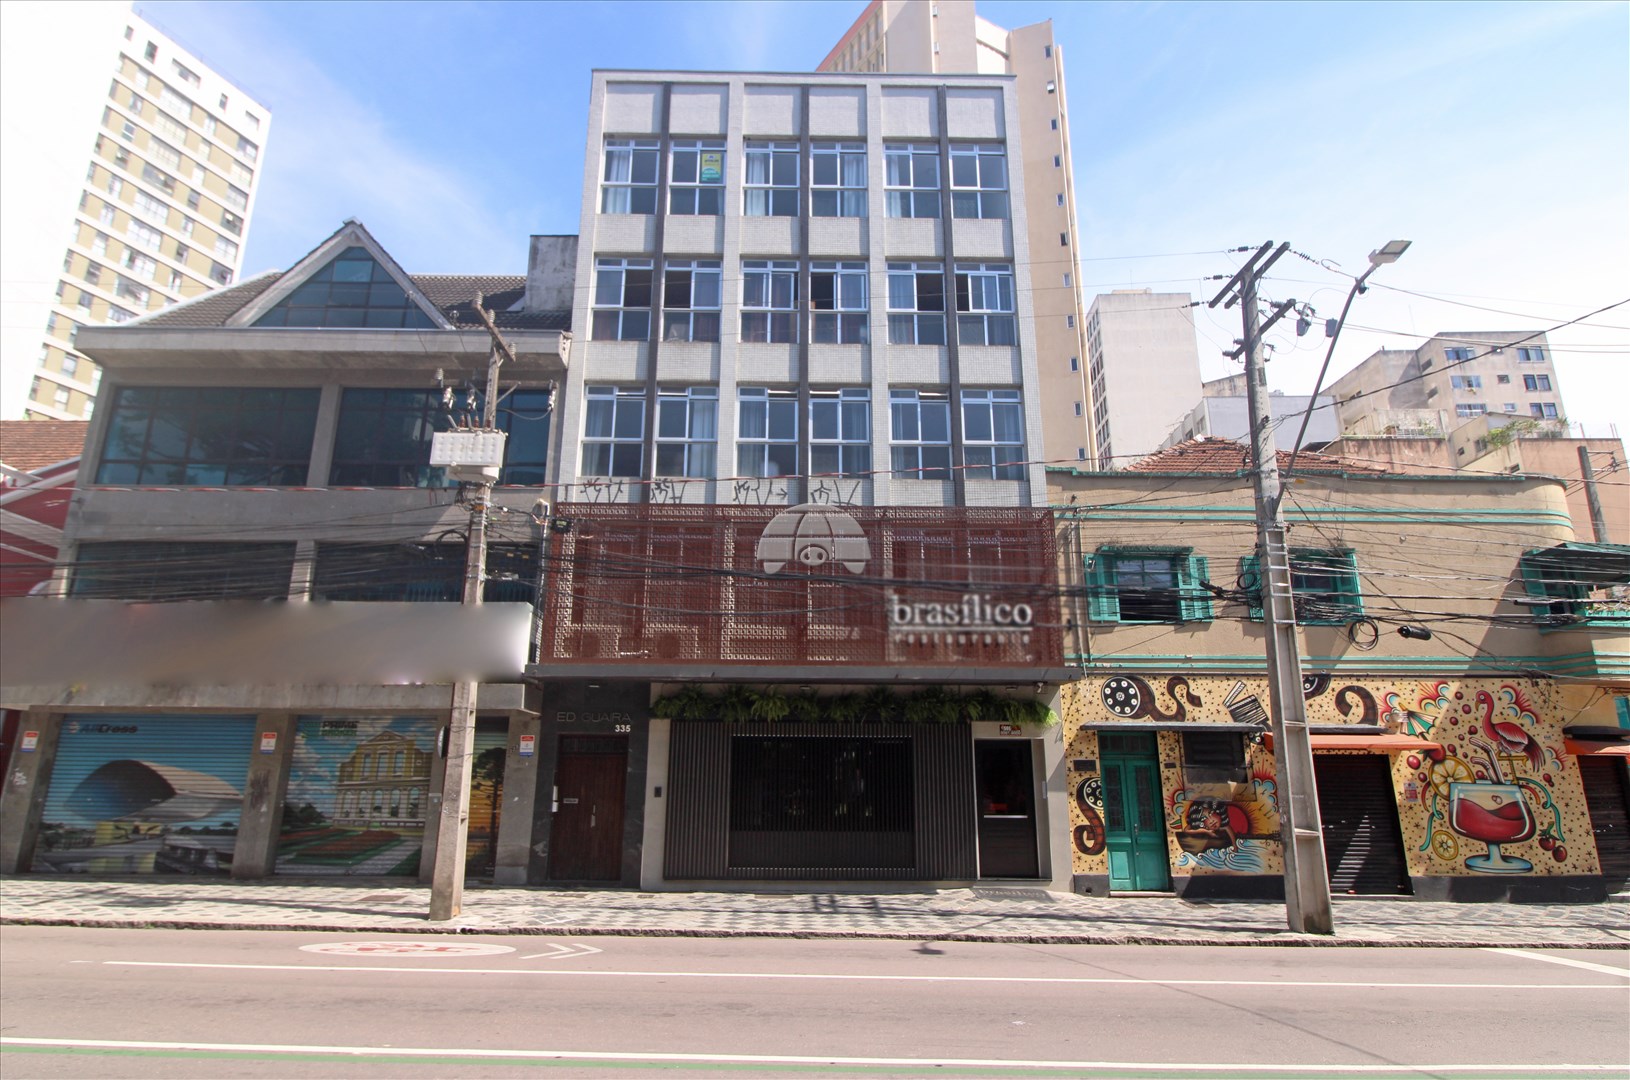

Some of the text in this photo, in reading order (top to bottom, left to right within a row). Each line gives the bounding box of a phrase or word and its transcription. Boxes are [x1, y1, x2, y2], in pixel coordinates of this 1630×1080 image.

[891, 594, 1033, 625] brasílico
[556, 711, 576, 722] ED
[614, 724, 631, 733] 335
